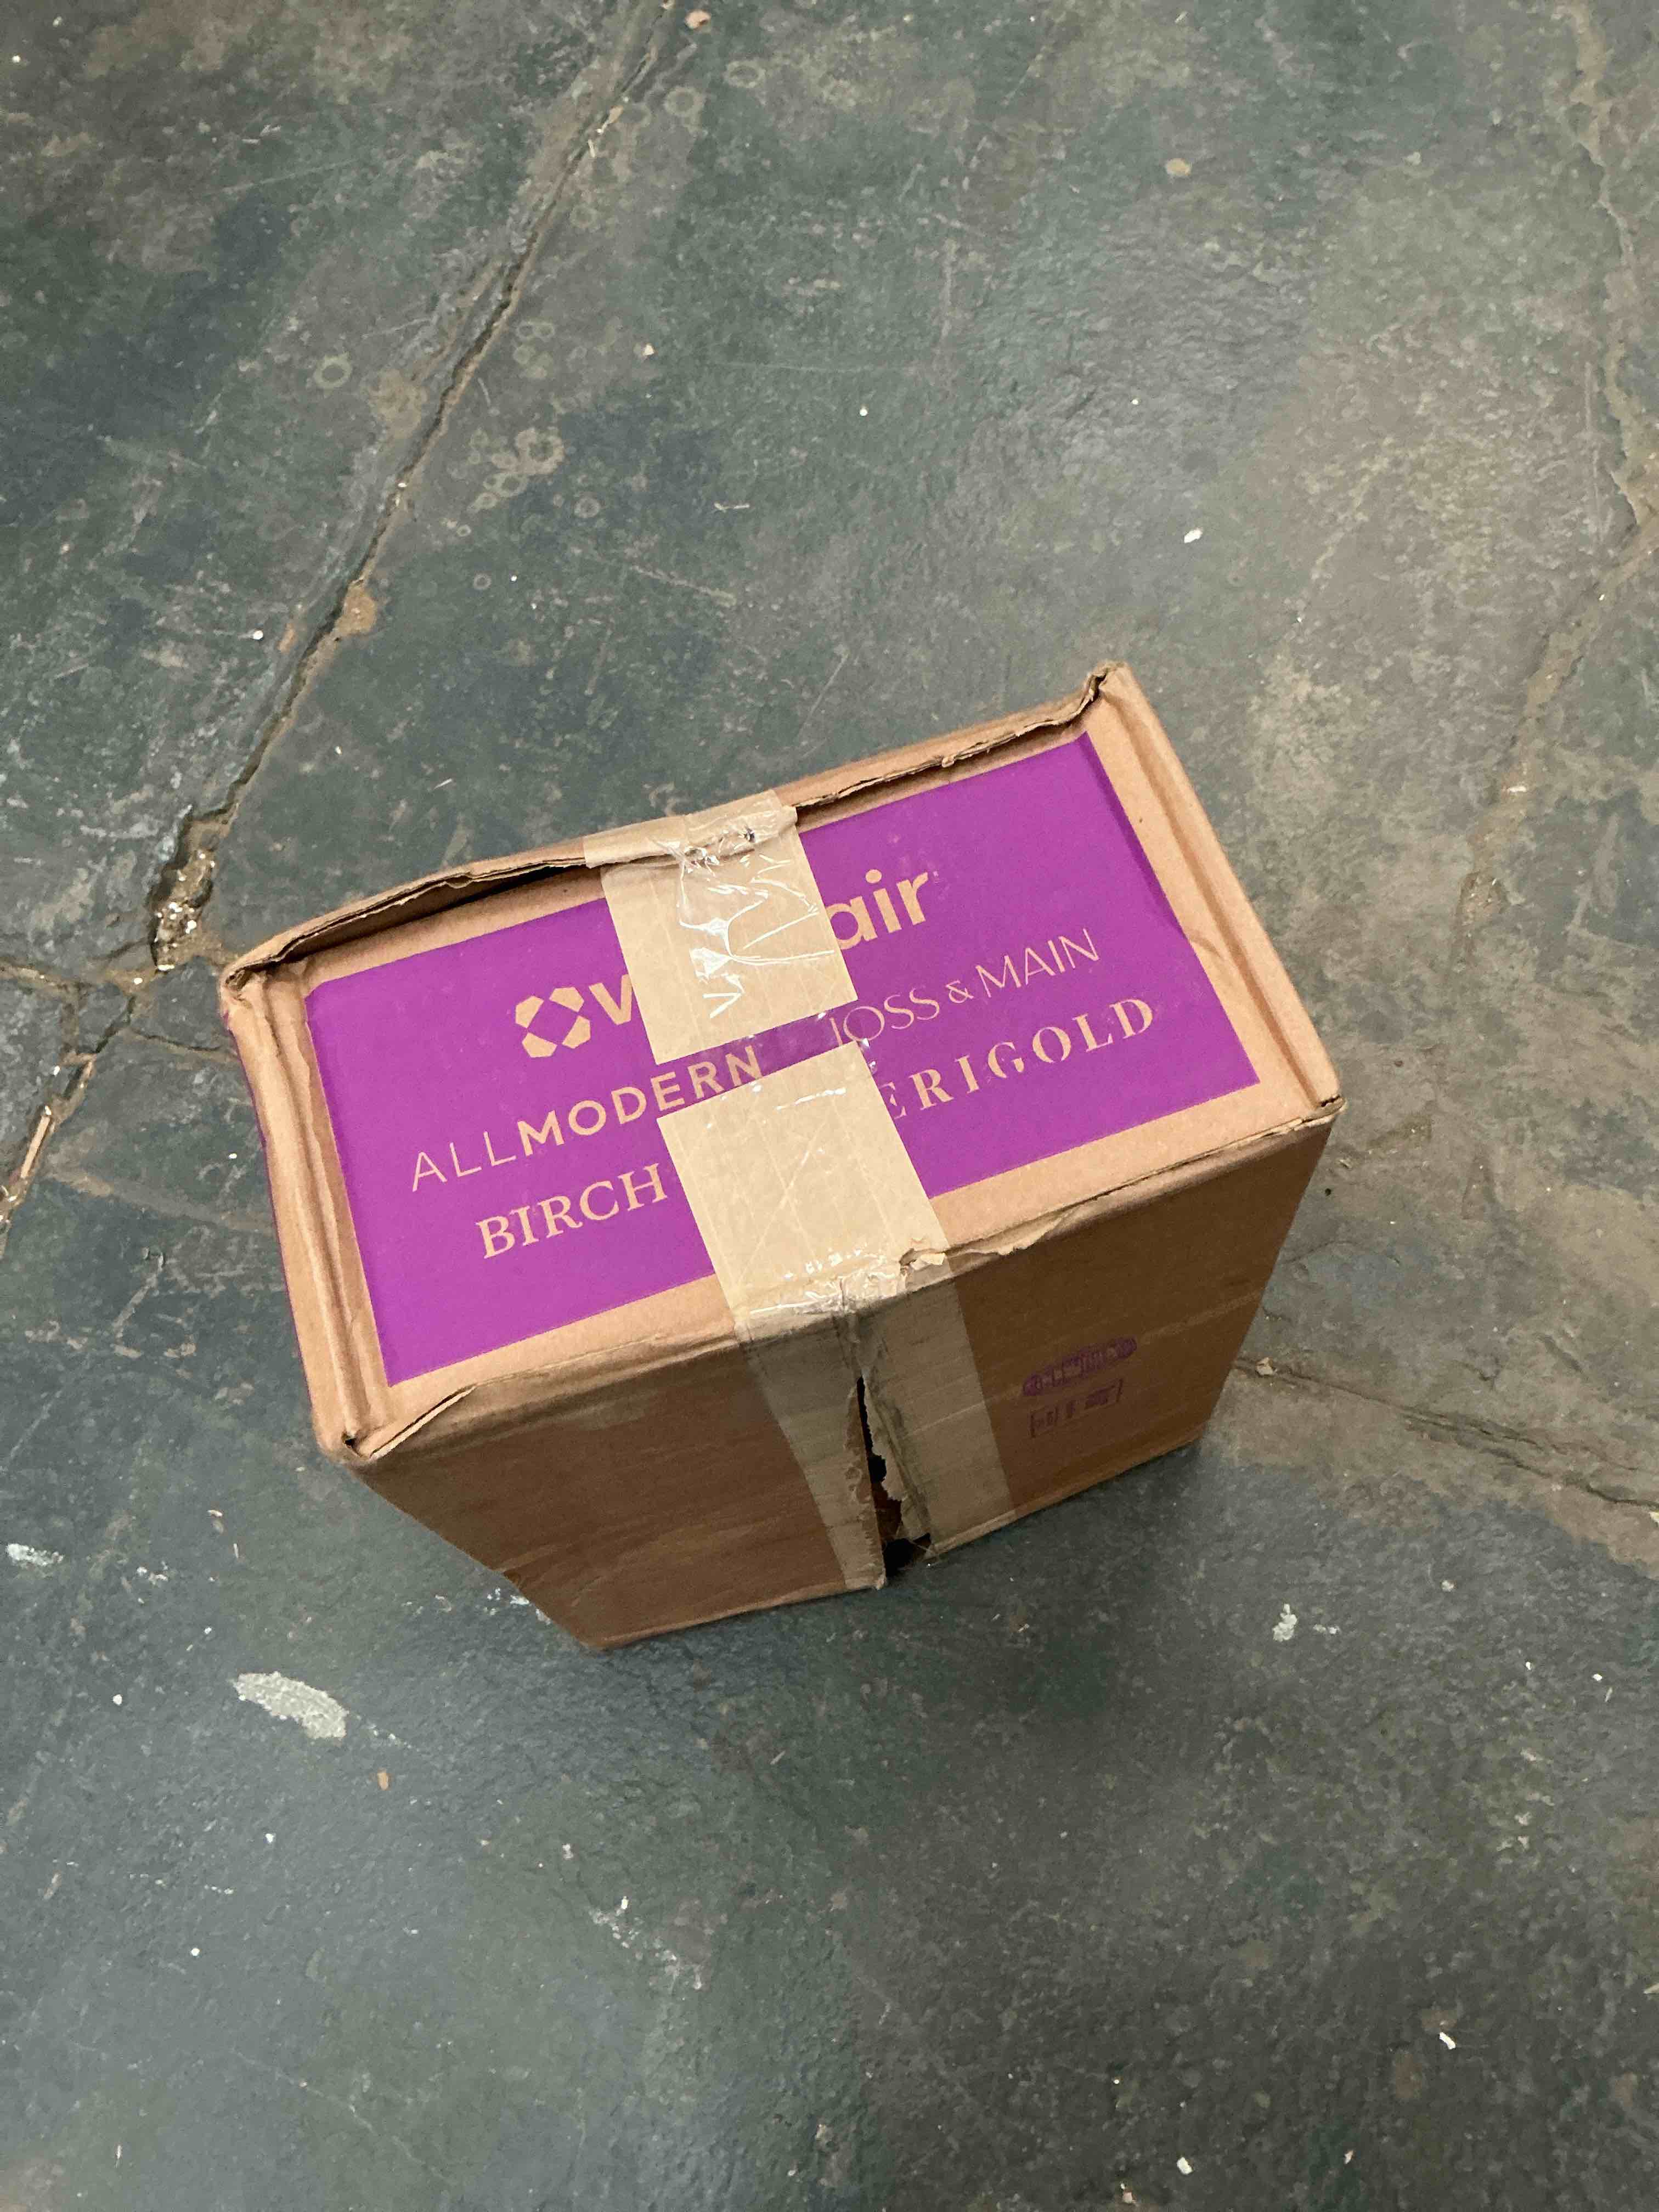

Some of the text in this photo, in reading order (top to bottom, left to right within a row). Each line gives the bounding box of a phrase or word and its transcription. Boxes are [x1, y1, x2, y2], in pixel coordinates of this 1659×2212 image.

[945, 980, 974, 1004] &
[975, 928, 1100, 998] MAIN
[411, 1045, 763, 1192] ALLMODERN
[476, 997, 1154, 1259] BIRCH ERIGOLD
